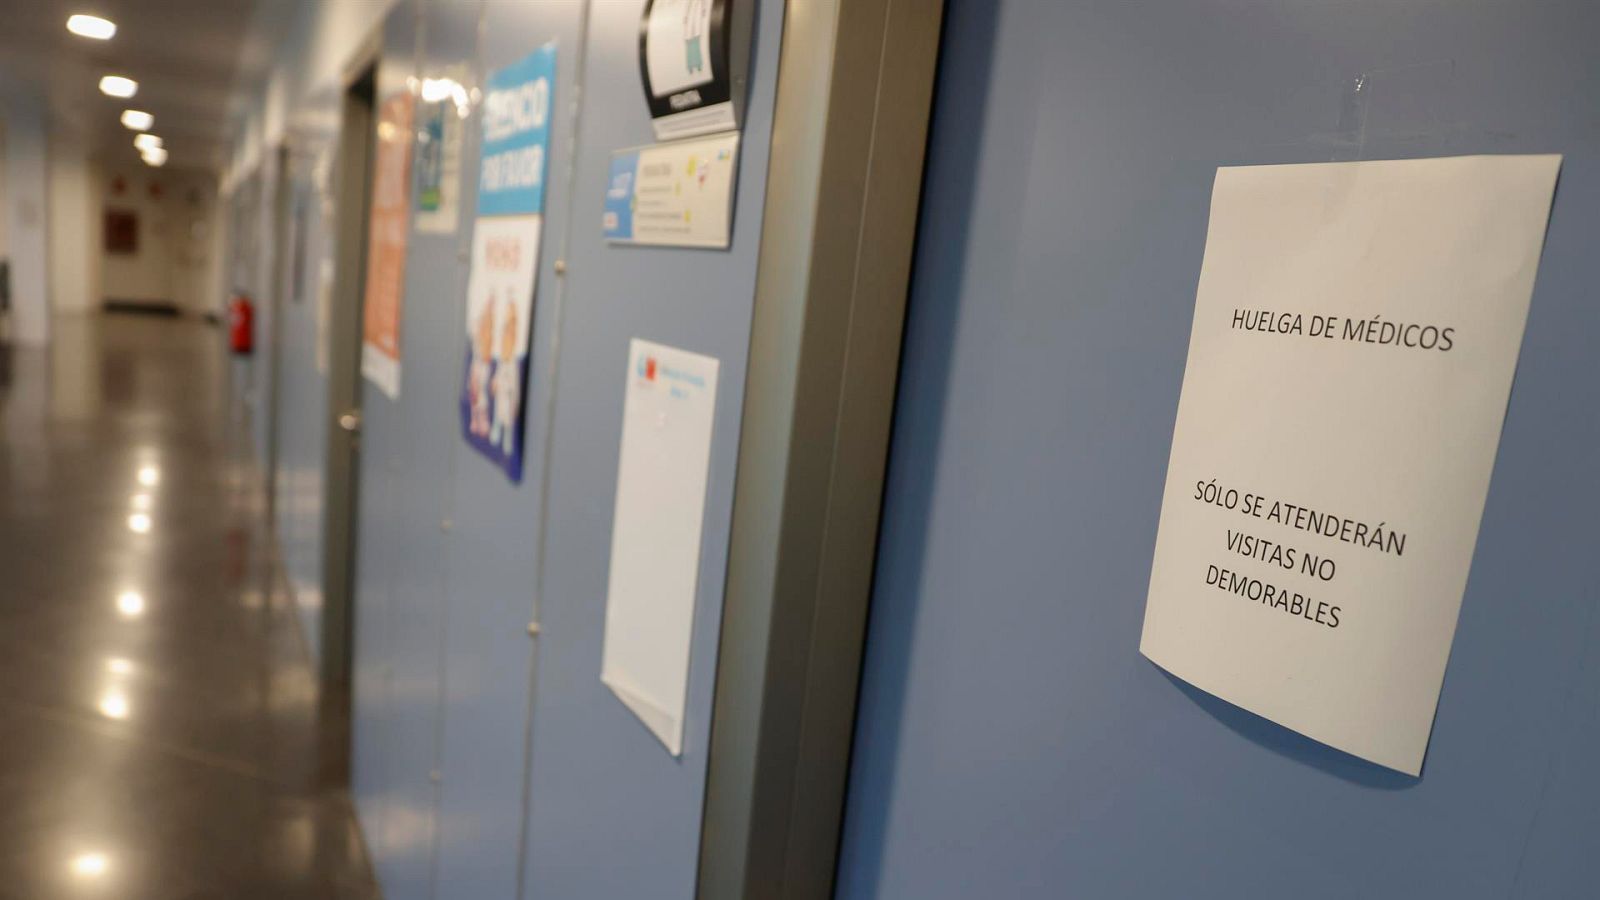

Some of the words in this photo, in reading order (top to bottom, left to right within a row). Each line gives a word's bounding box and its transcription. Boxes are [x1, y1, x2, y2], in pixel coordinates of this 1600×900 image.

[1231, 308, 1303, 336] HUELGA
[1308, 314, 1338, 339] DE
[1341, 314, 1456, 352] MÉDICOS
[1193, 478, 1239, 510] SÓLO
[1241, 493, 1266, 518] SE
[1266, 500, 1407, 557] ATENDERÁN
[1226, 529, 1297, 570] VISITAS
[1300, 552, 1336, 582] NO
[1205, 564, 1342, 629] DEMORABLES
